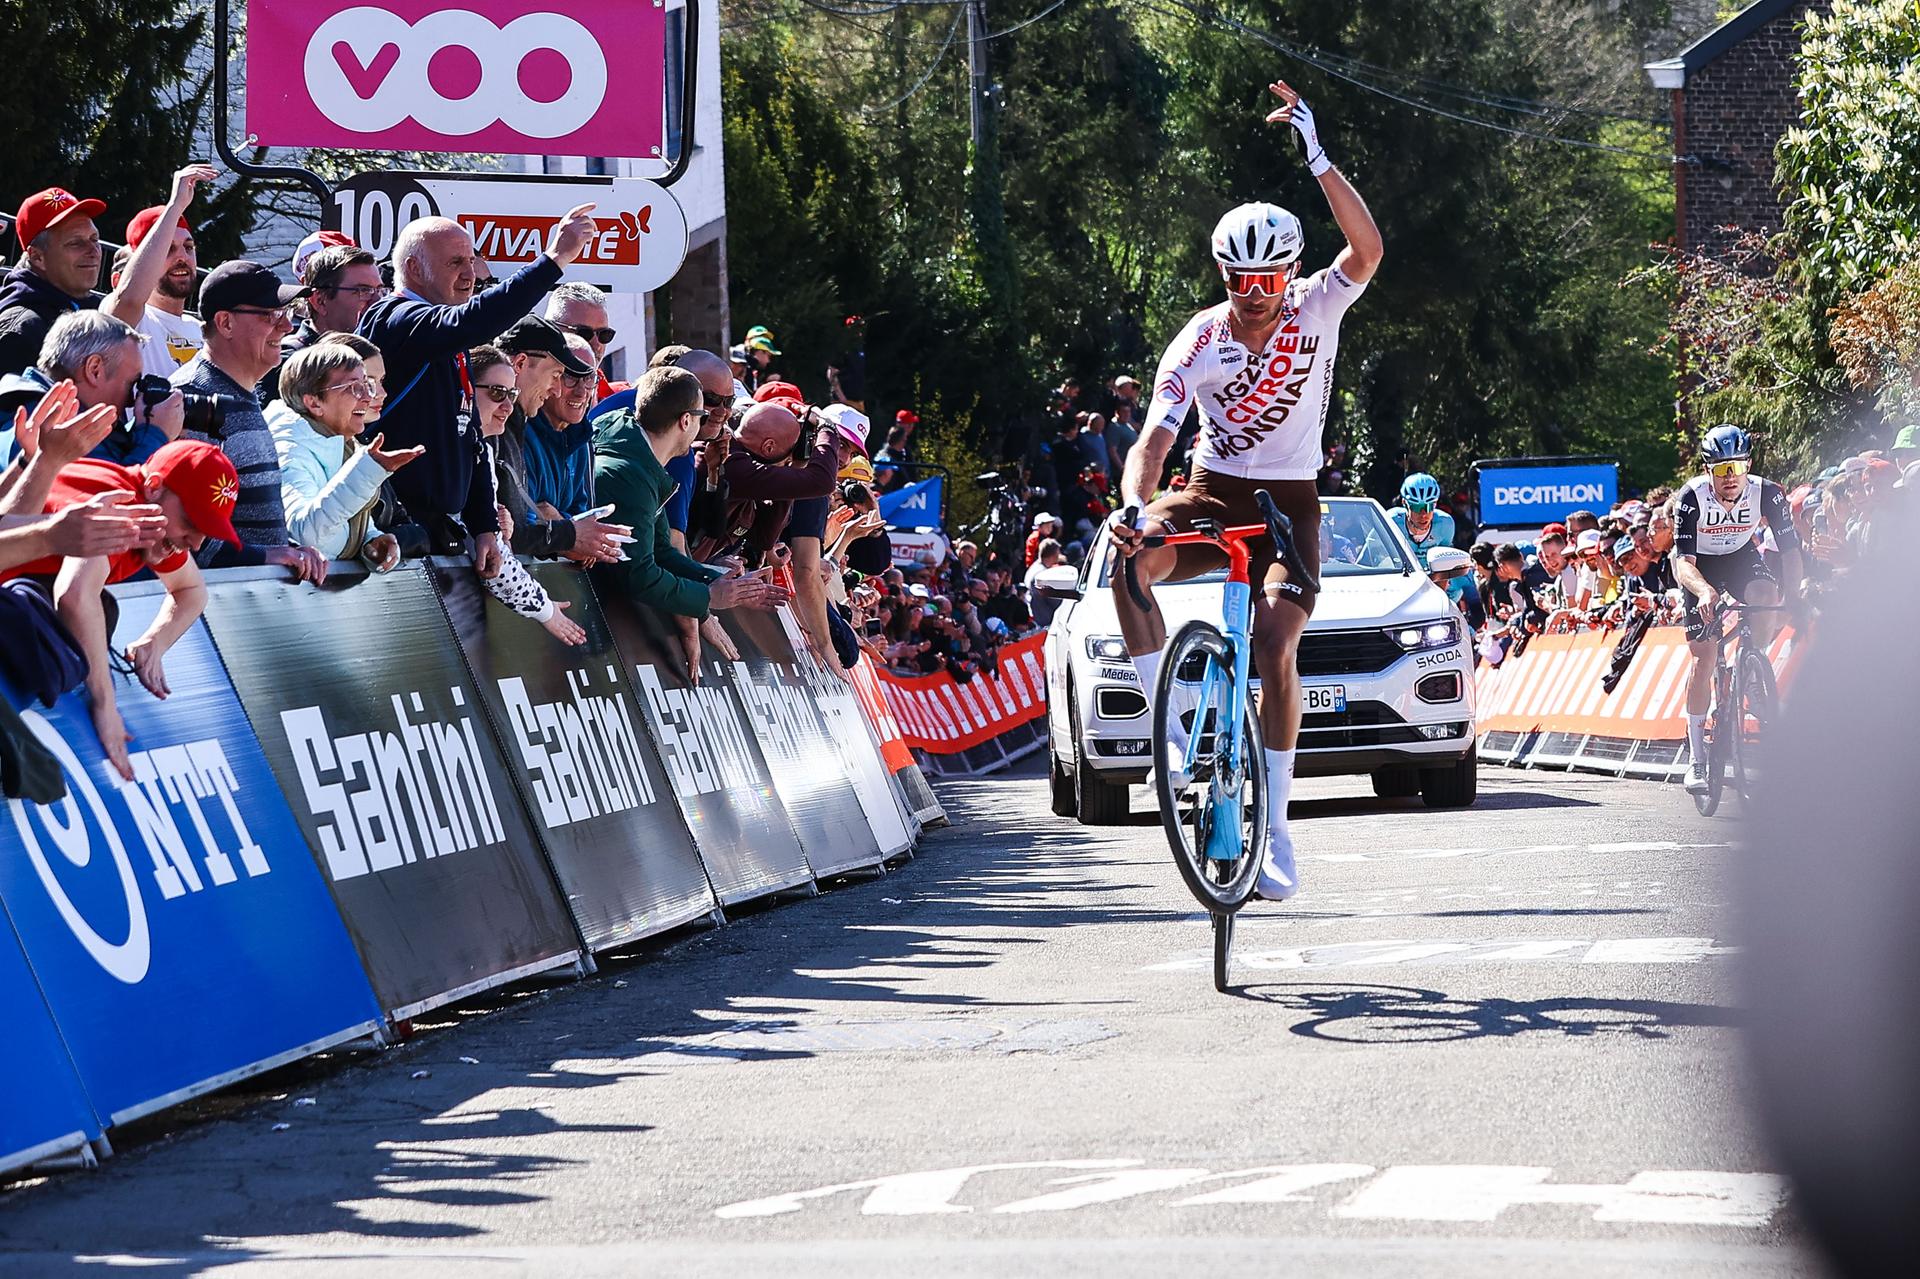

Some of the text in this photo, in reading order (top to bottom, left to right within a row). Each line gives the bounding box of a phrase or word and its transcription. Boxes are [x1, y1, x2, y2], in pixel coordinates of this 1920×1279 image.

[1211, 336, 1320, 460] MONDIALE
[1494, 483, 1603, 505] DECATHLON
[1706, 508, 1750, 526] UAE
[280, 686, 506, 882] Santini
[497, 665, 656, 828] Santini
[636, 661, 760, 798] Santini
[102, 738, 271, 900] NTT
